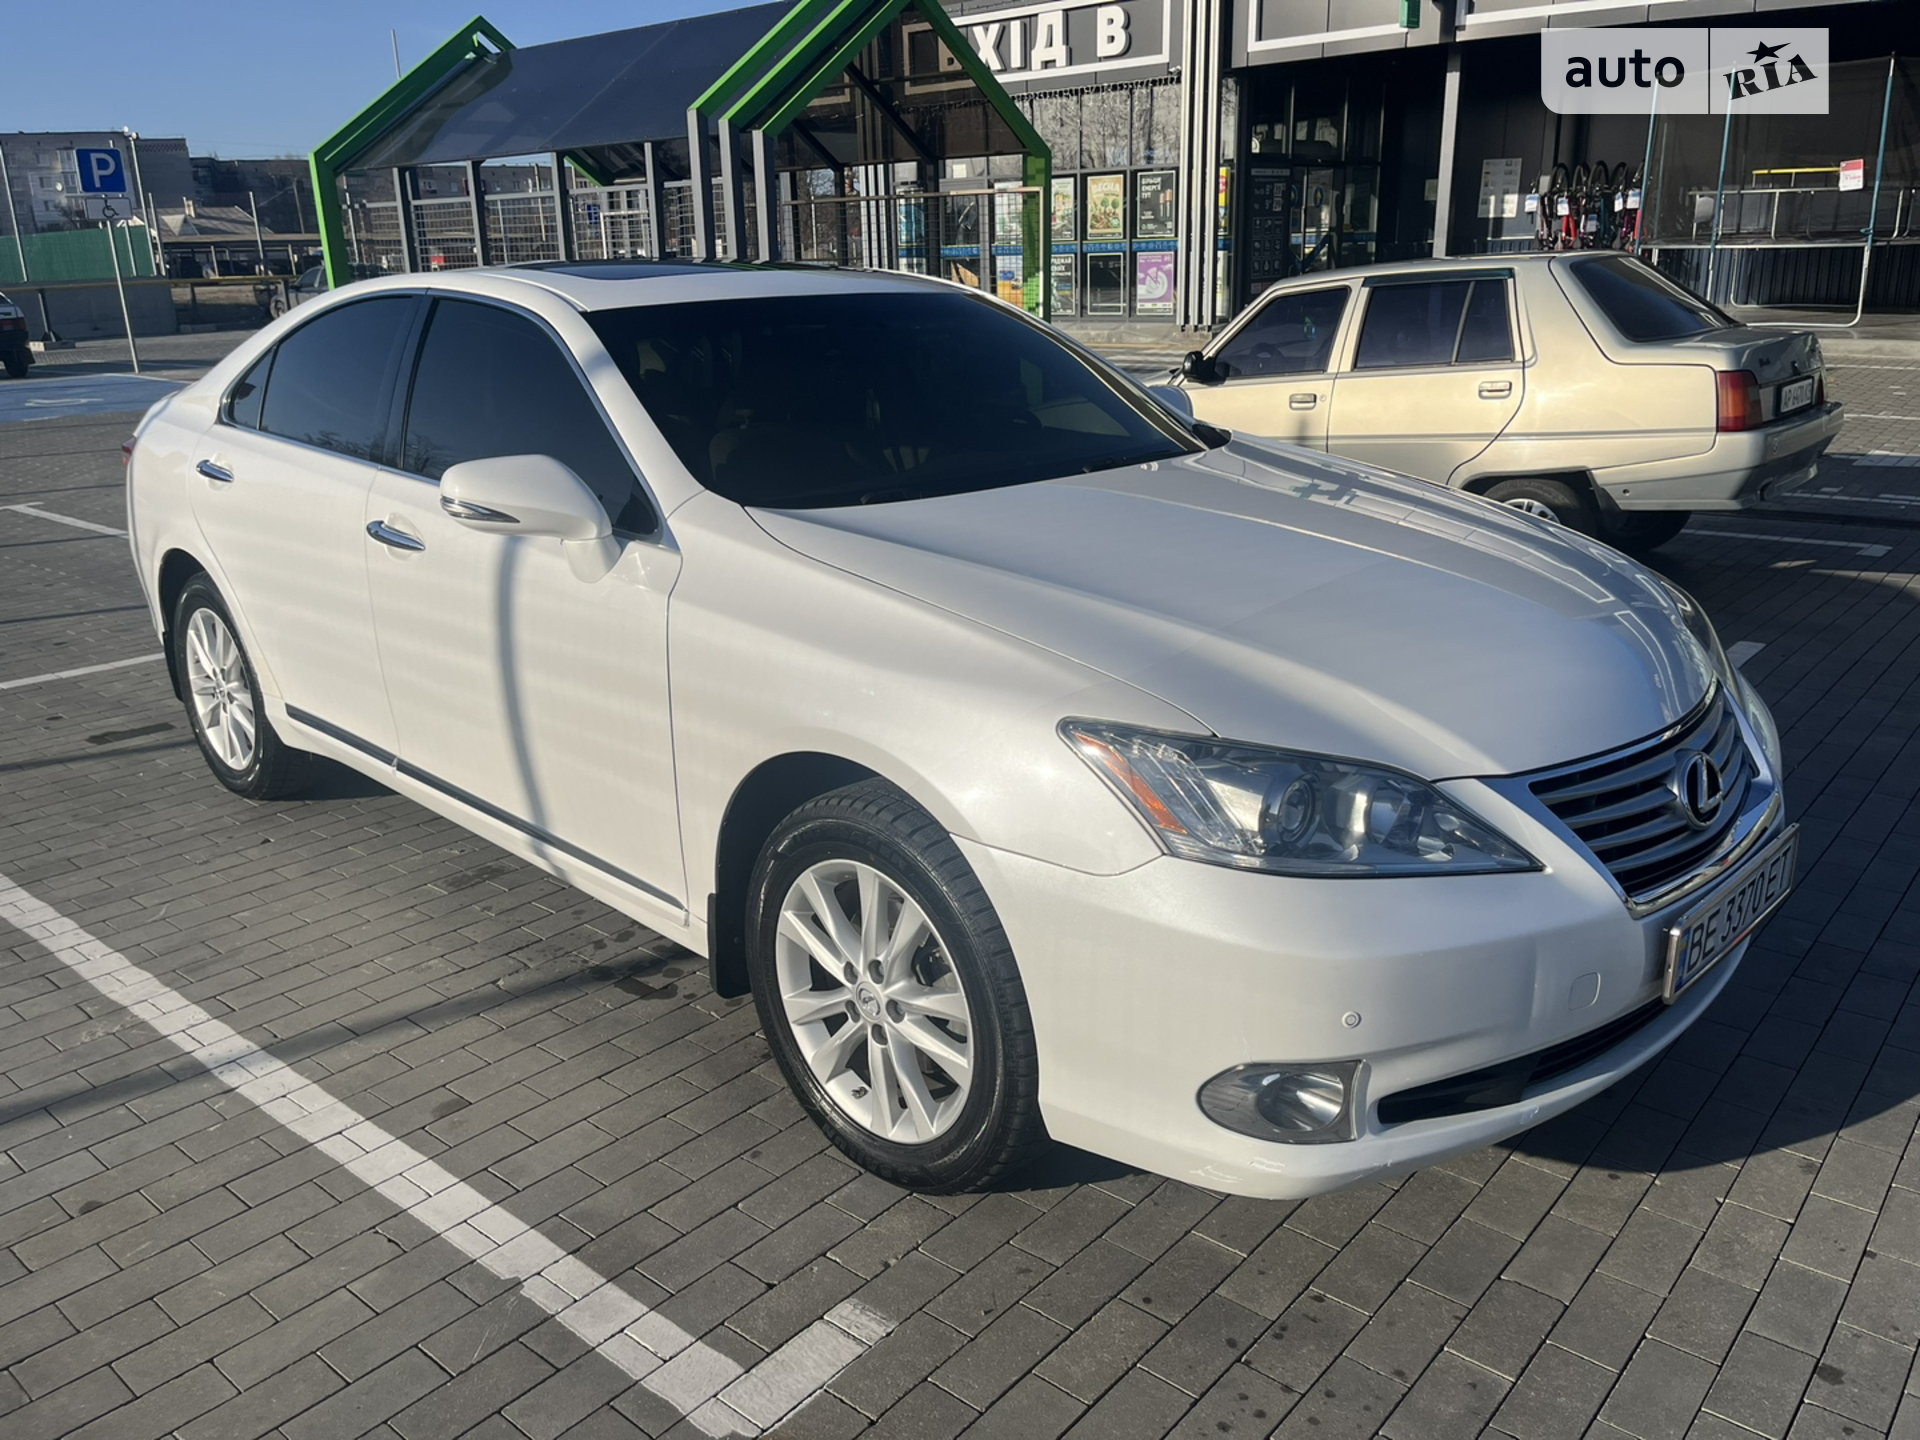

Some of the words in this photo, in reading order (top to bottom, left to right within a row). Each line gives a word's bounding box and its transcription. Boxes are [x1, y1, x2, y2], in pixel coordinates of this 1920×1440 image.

[1096, 5, 1129, 57] В
[90, 152, 116, 188] P
[1687, 909, 1721, 974] BE
[1721, 870, 1765, 942] 3370
[1766, 845, 1792, 904] ET
